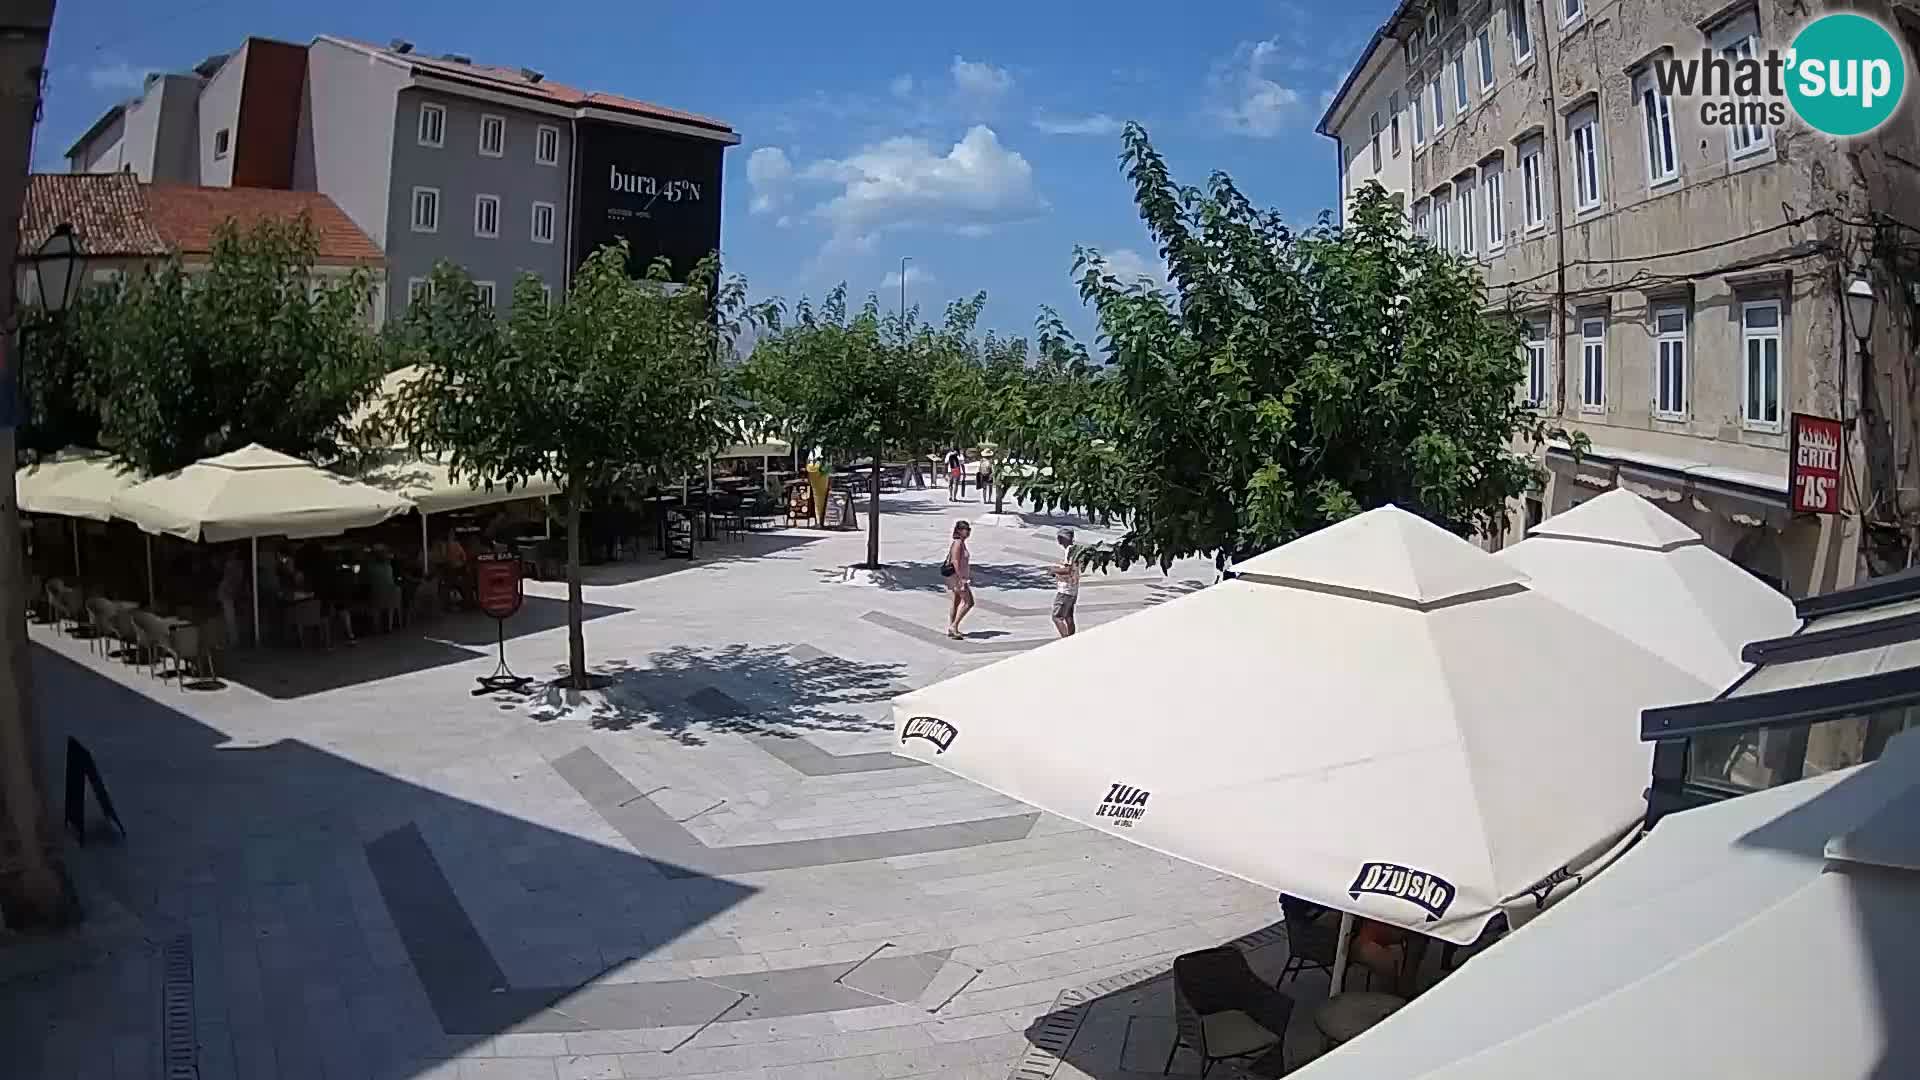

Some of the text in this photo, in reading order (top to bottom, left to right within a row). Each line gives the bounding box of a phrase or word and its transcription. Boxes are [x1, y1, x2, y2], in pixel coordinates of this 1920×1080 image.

[610, 164, 657, 196] bura
[1797, 446, 1838, 471] GRILL
[1095, 804, 1146, 820] JE ZAKON!
[1360, 864, 1447, 909] Ožujsko
